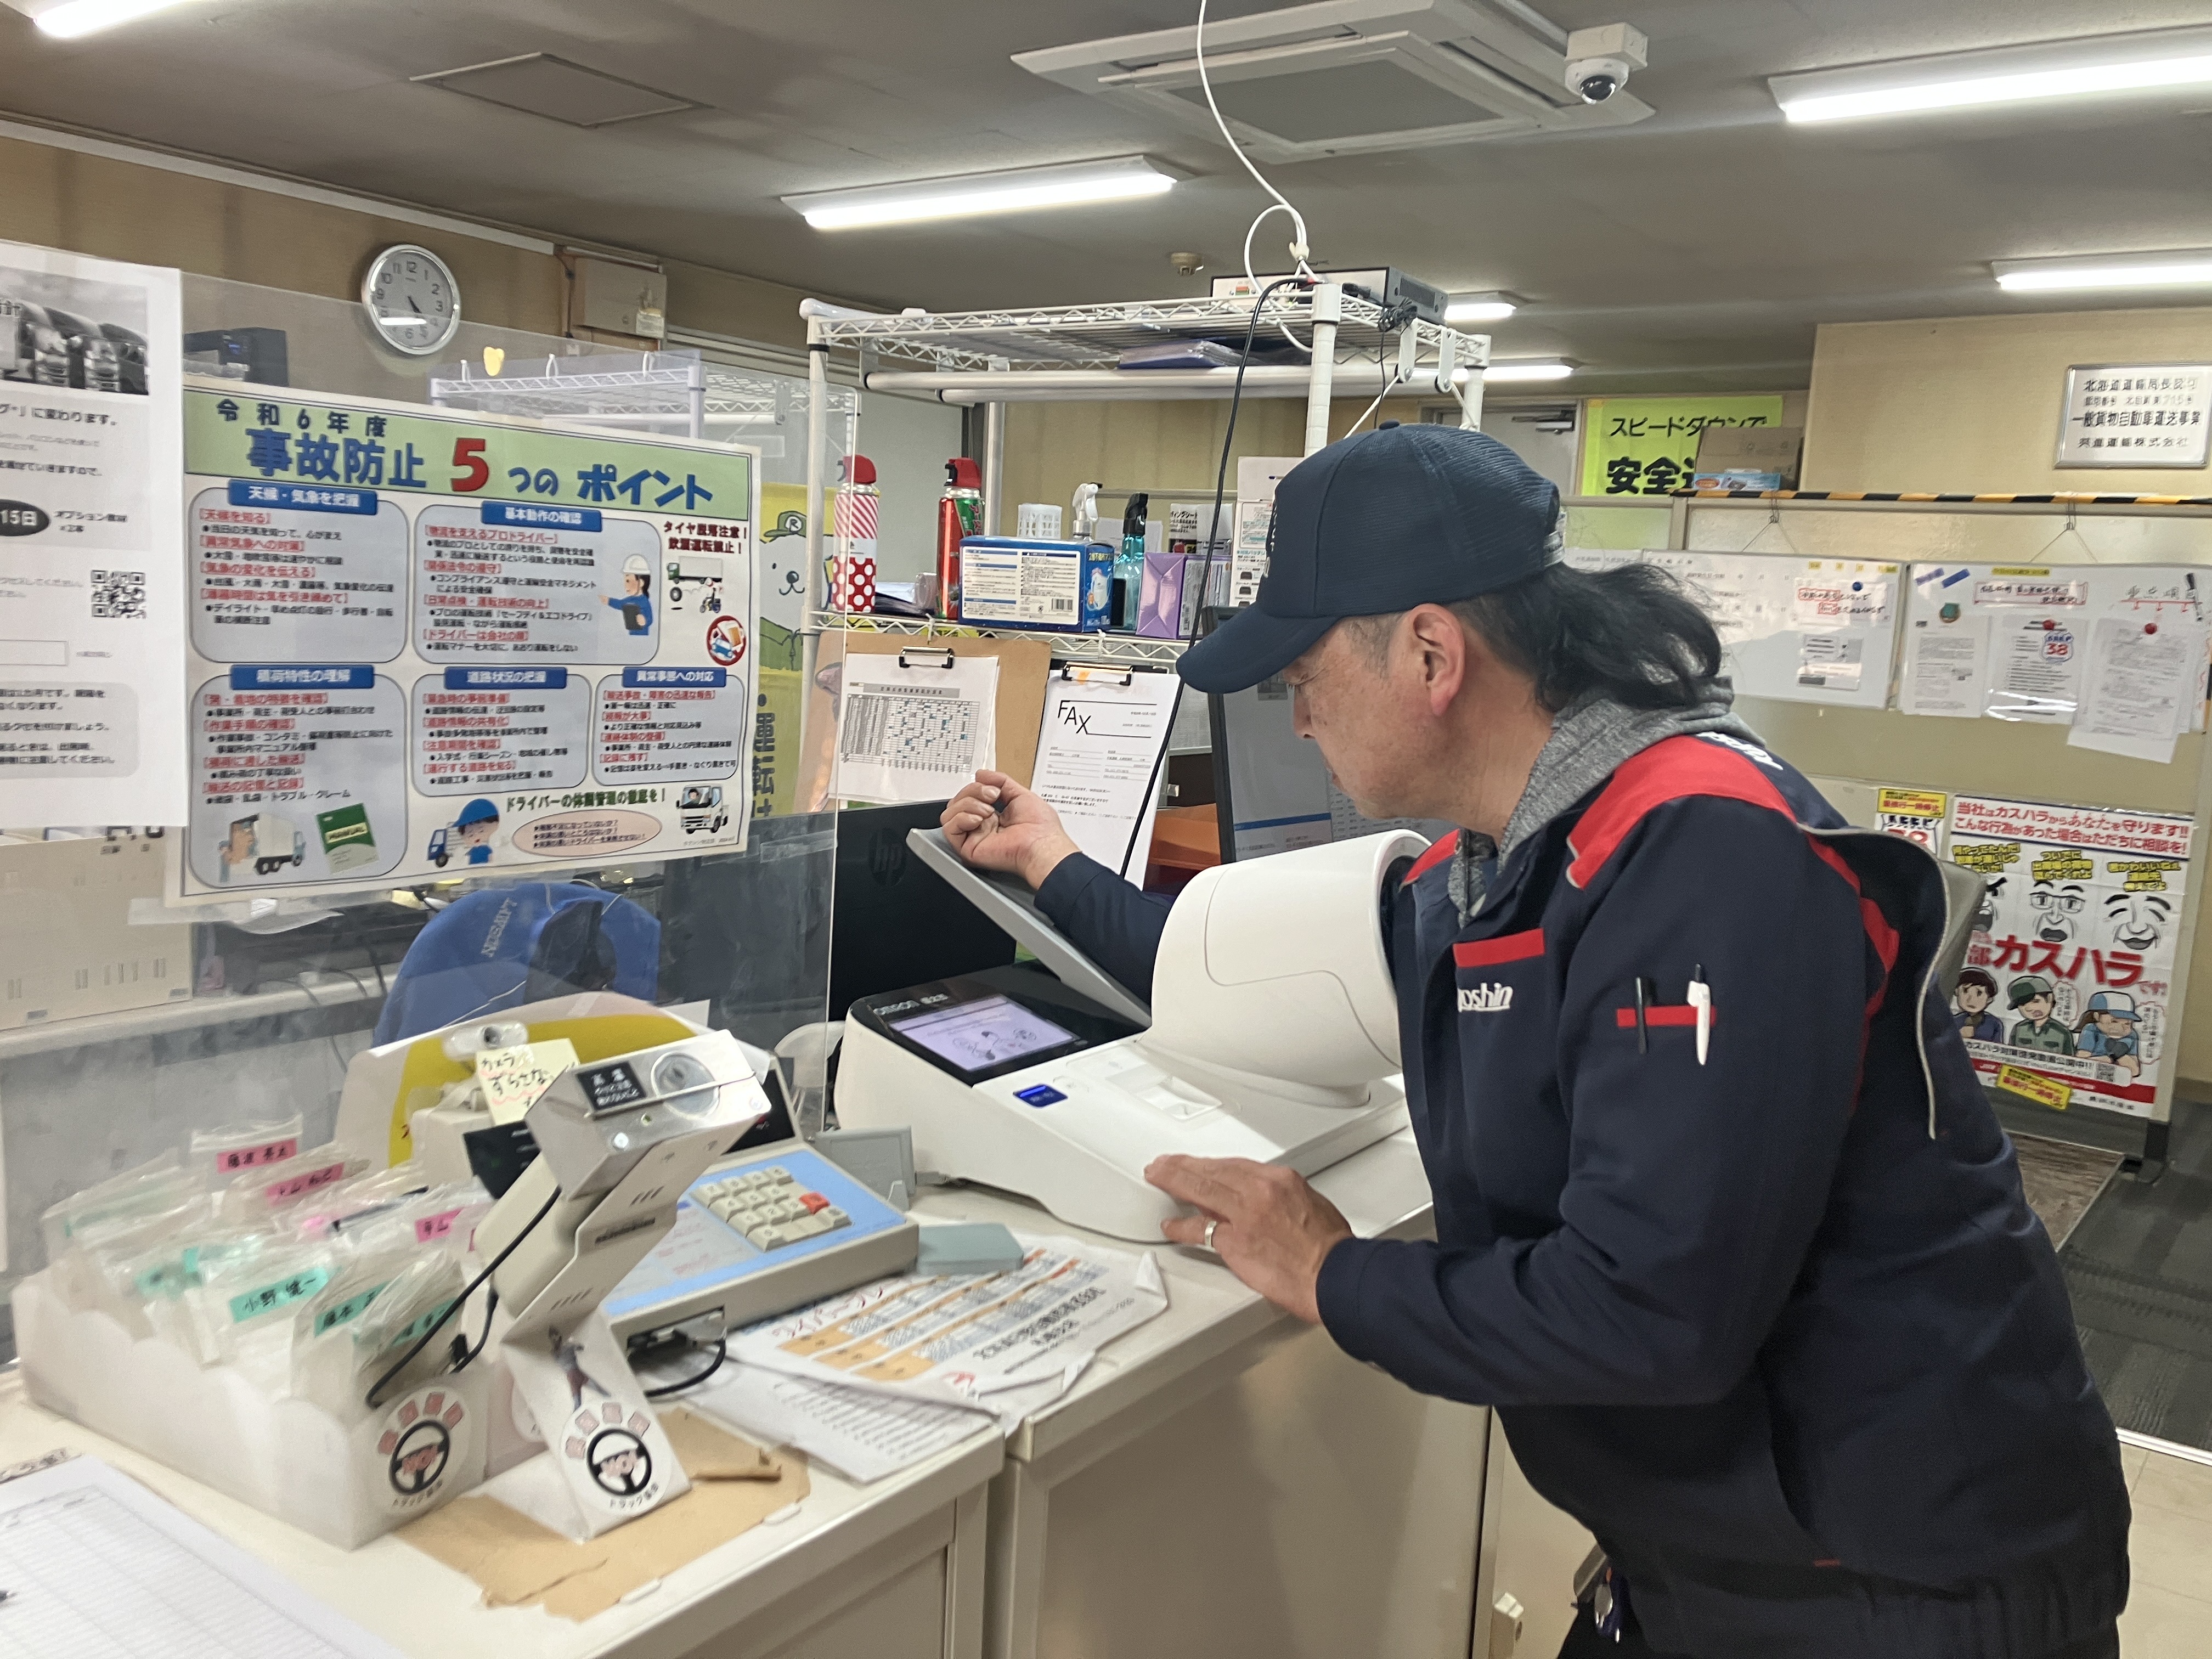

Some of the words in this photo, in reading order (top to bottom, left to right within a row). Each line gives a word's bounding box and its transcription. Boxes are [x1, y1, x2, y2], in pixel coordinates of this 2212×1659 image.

[245, 428, 427, 489] 事故防止
[450, 437, 489, 493] 5
[508, 466, 558, 496] つの
[577, 464, 713, 510] ポイント
[1605, 456, 1694, 494] 安全
[788, 518, 799, 532] R
[1058, 700, 1091, 734] FAX
[1956, 801, 2189, 838] 当社はカスハラからあなたを守ります!!
[1993, 935, 2144, 986] カスハラ
